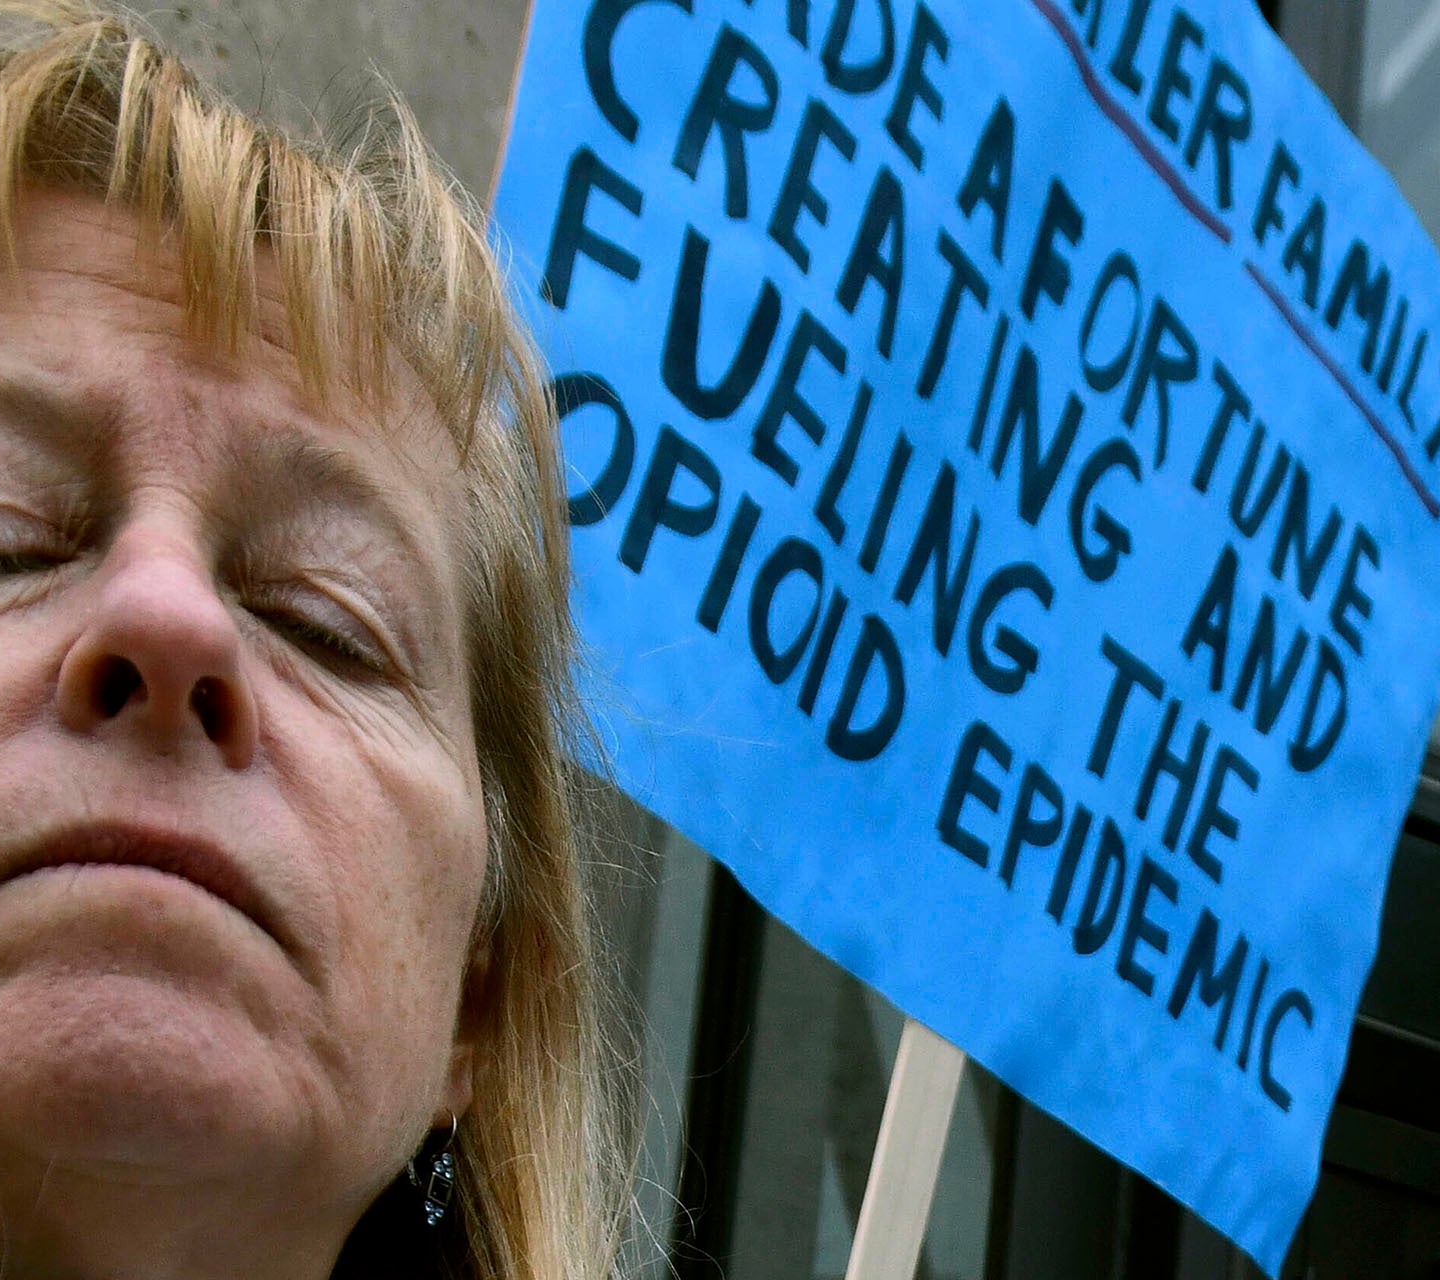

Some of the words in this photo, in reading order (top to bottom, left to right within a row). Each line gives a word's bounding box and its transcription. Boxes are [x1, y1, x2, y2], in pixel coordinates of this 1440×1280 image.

[540, 146, 1055, 694] FUELING
[1087, 633, 1259, 884] THE
[548, 369, 907, 761] OPIOID
[937, 722, 1313, 1113] EPIDEMIC
[581, 0, 1140, 583] CREATING
[1180, 545, 1348, 772] AND
[957, 96, 1014, 262] A
[1018, 178, 1380, 656] FORTUNE
